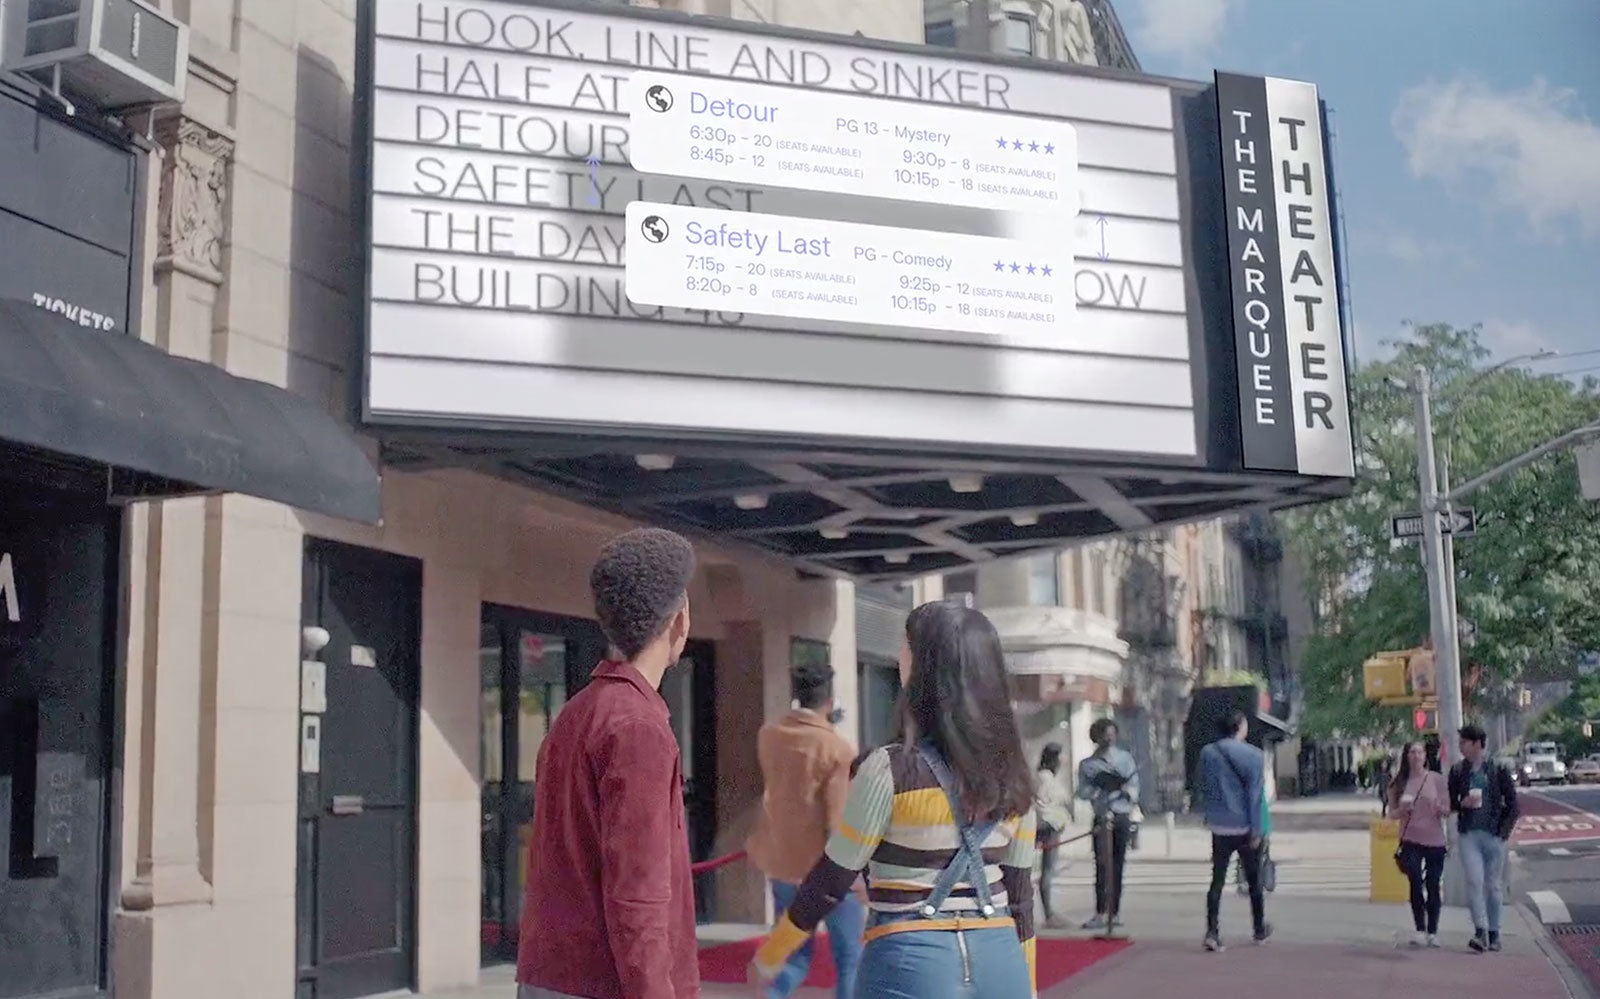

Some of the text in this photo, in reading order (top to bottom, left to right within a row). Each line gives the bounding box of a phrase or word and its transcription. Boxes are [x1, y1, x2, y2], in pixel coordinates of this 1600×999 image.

[416, 3, 1011, 109] HOOK, LINE AND SINKER
[416, 53, 552, 101] HALF
[415, 105, 630, 162] DETOUR
[413, 157, 618, 210] SAFETY
[411, 208, 627, 264] THE DAY
[1232, 110, 1275, 425] THE MARQUEE
[1278, 117, 1334, 429] THEATER
